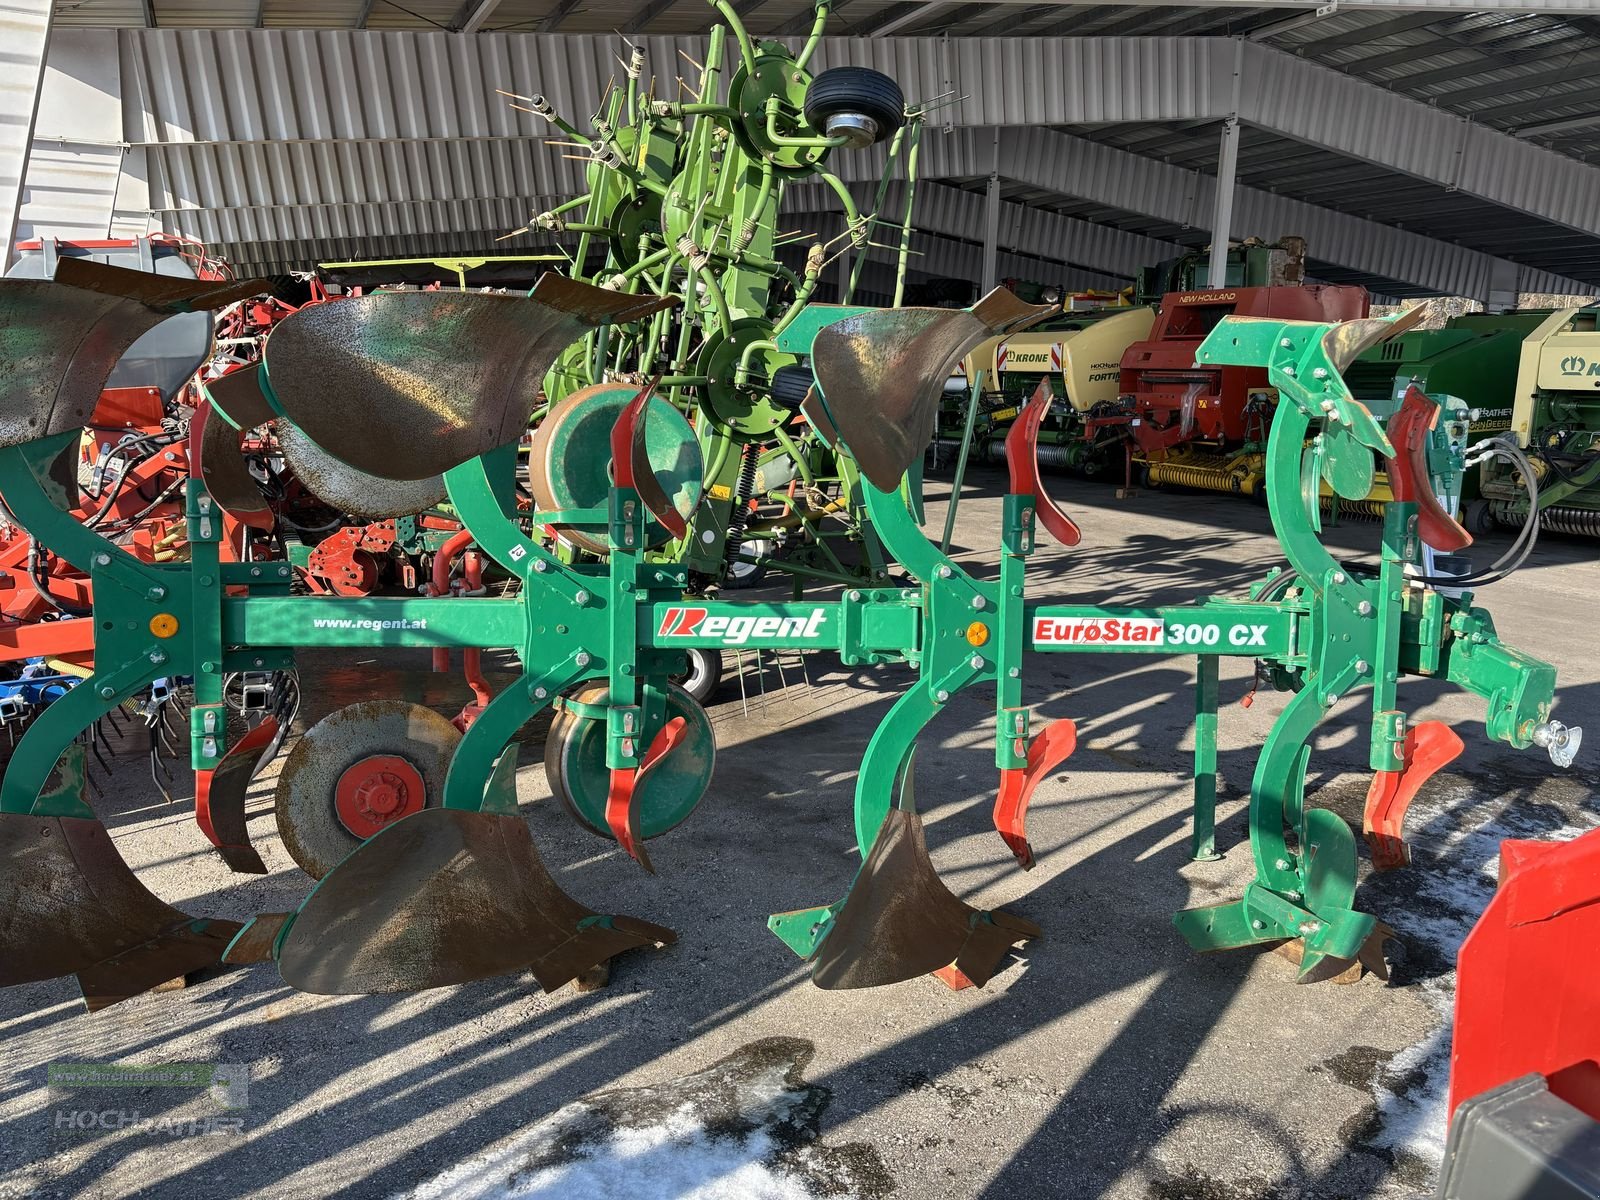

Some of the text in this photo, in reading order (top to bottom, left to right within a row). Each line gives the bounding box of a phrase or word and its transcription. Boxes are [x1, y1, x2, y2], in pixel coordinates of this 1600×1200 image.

[1179, 293, 1236, 303] NEW HOLLAND
[1015, 353, 1049, 362] KRONE
[1469, 419, 1512, 430] OHN DEERE
[313, 618, 427, 631] www.regent.at
[657, 607, 827, 644] Regent
[1167, 623, 1220, 646] 300
[1228, 624, 1269, 646] CX
